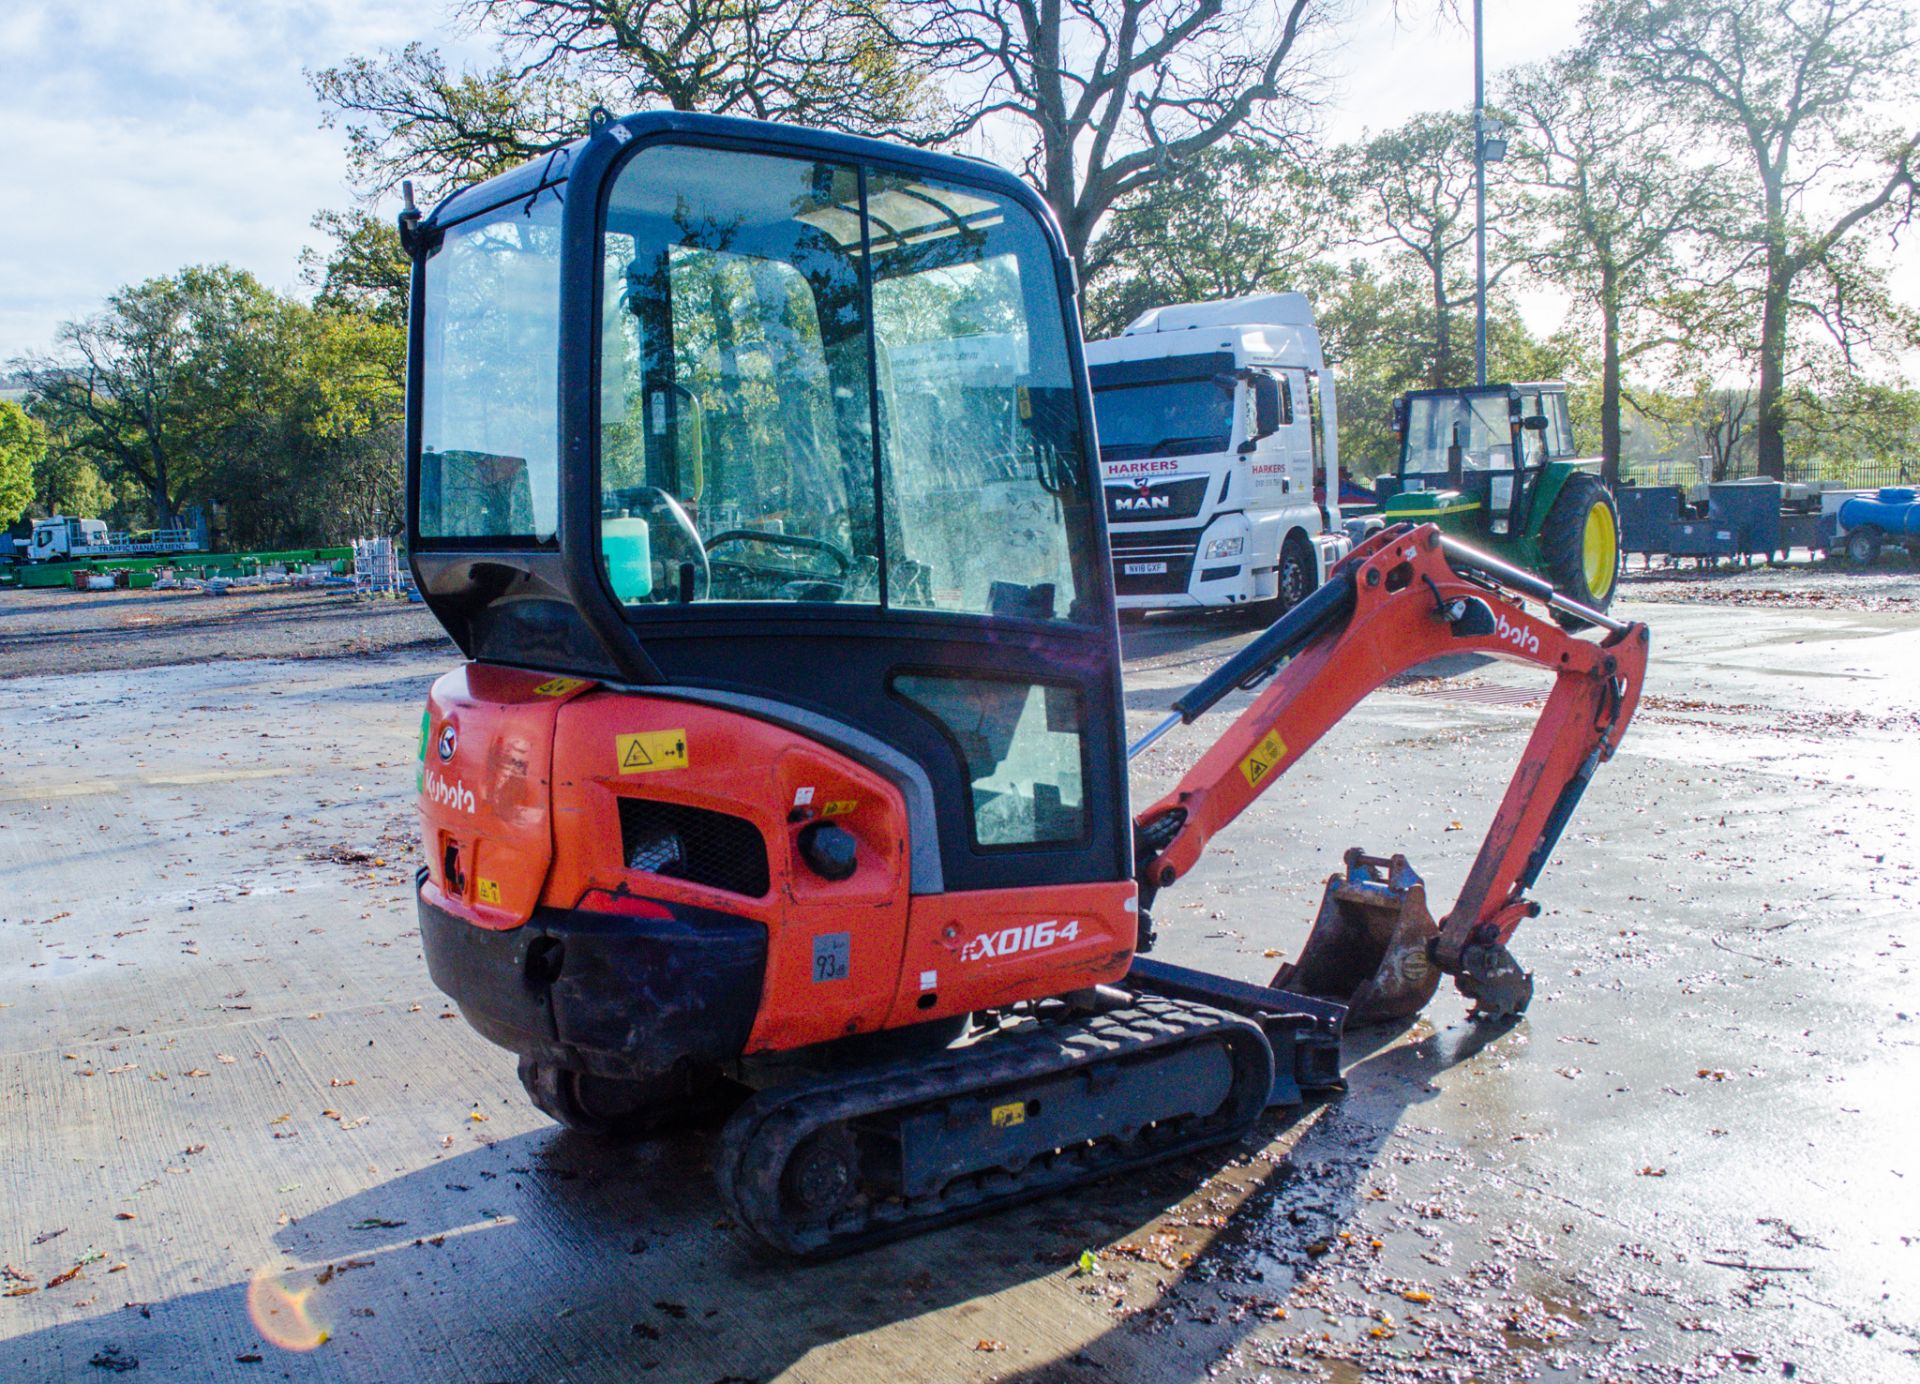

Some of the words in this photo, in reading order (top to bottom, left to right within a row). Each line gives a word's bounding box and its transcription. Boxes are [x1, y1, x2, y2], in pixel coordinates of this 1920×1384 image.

[1108, 460, 1179, 474] HARKERS
[1251, 464, 1286, 474] HARKERS
[1115, 495, 1169, 511] MAN
[98, 545, 131, 553] TRAFFIC
[1495, 613, 1540, 654] bota
[425, 769, 475, 814] Kubota
[816, 954, 836, 979] 93
